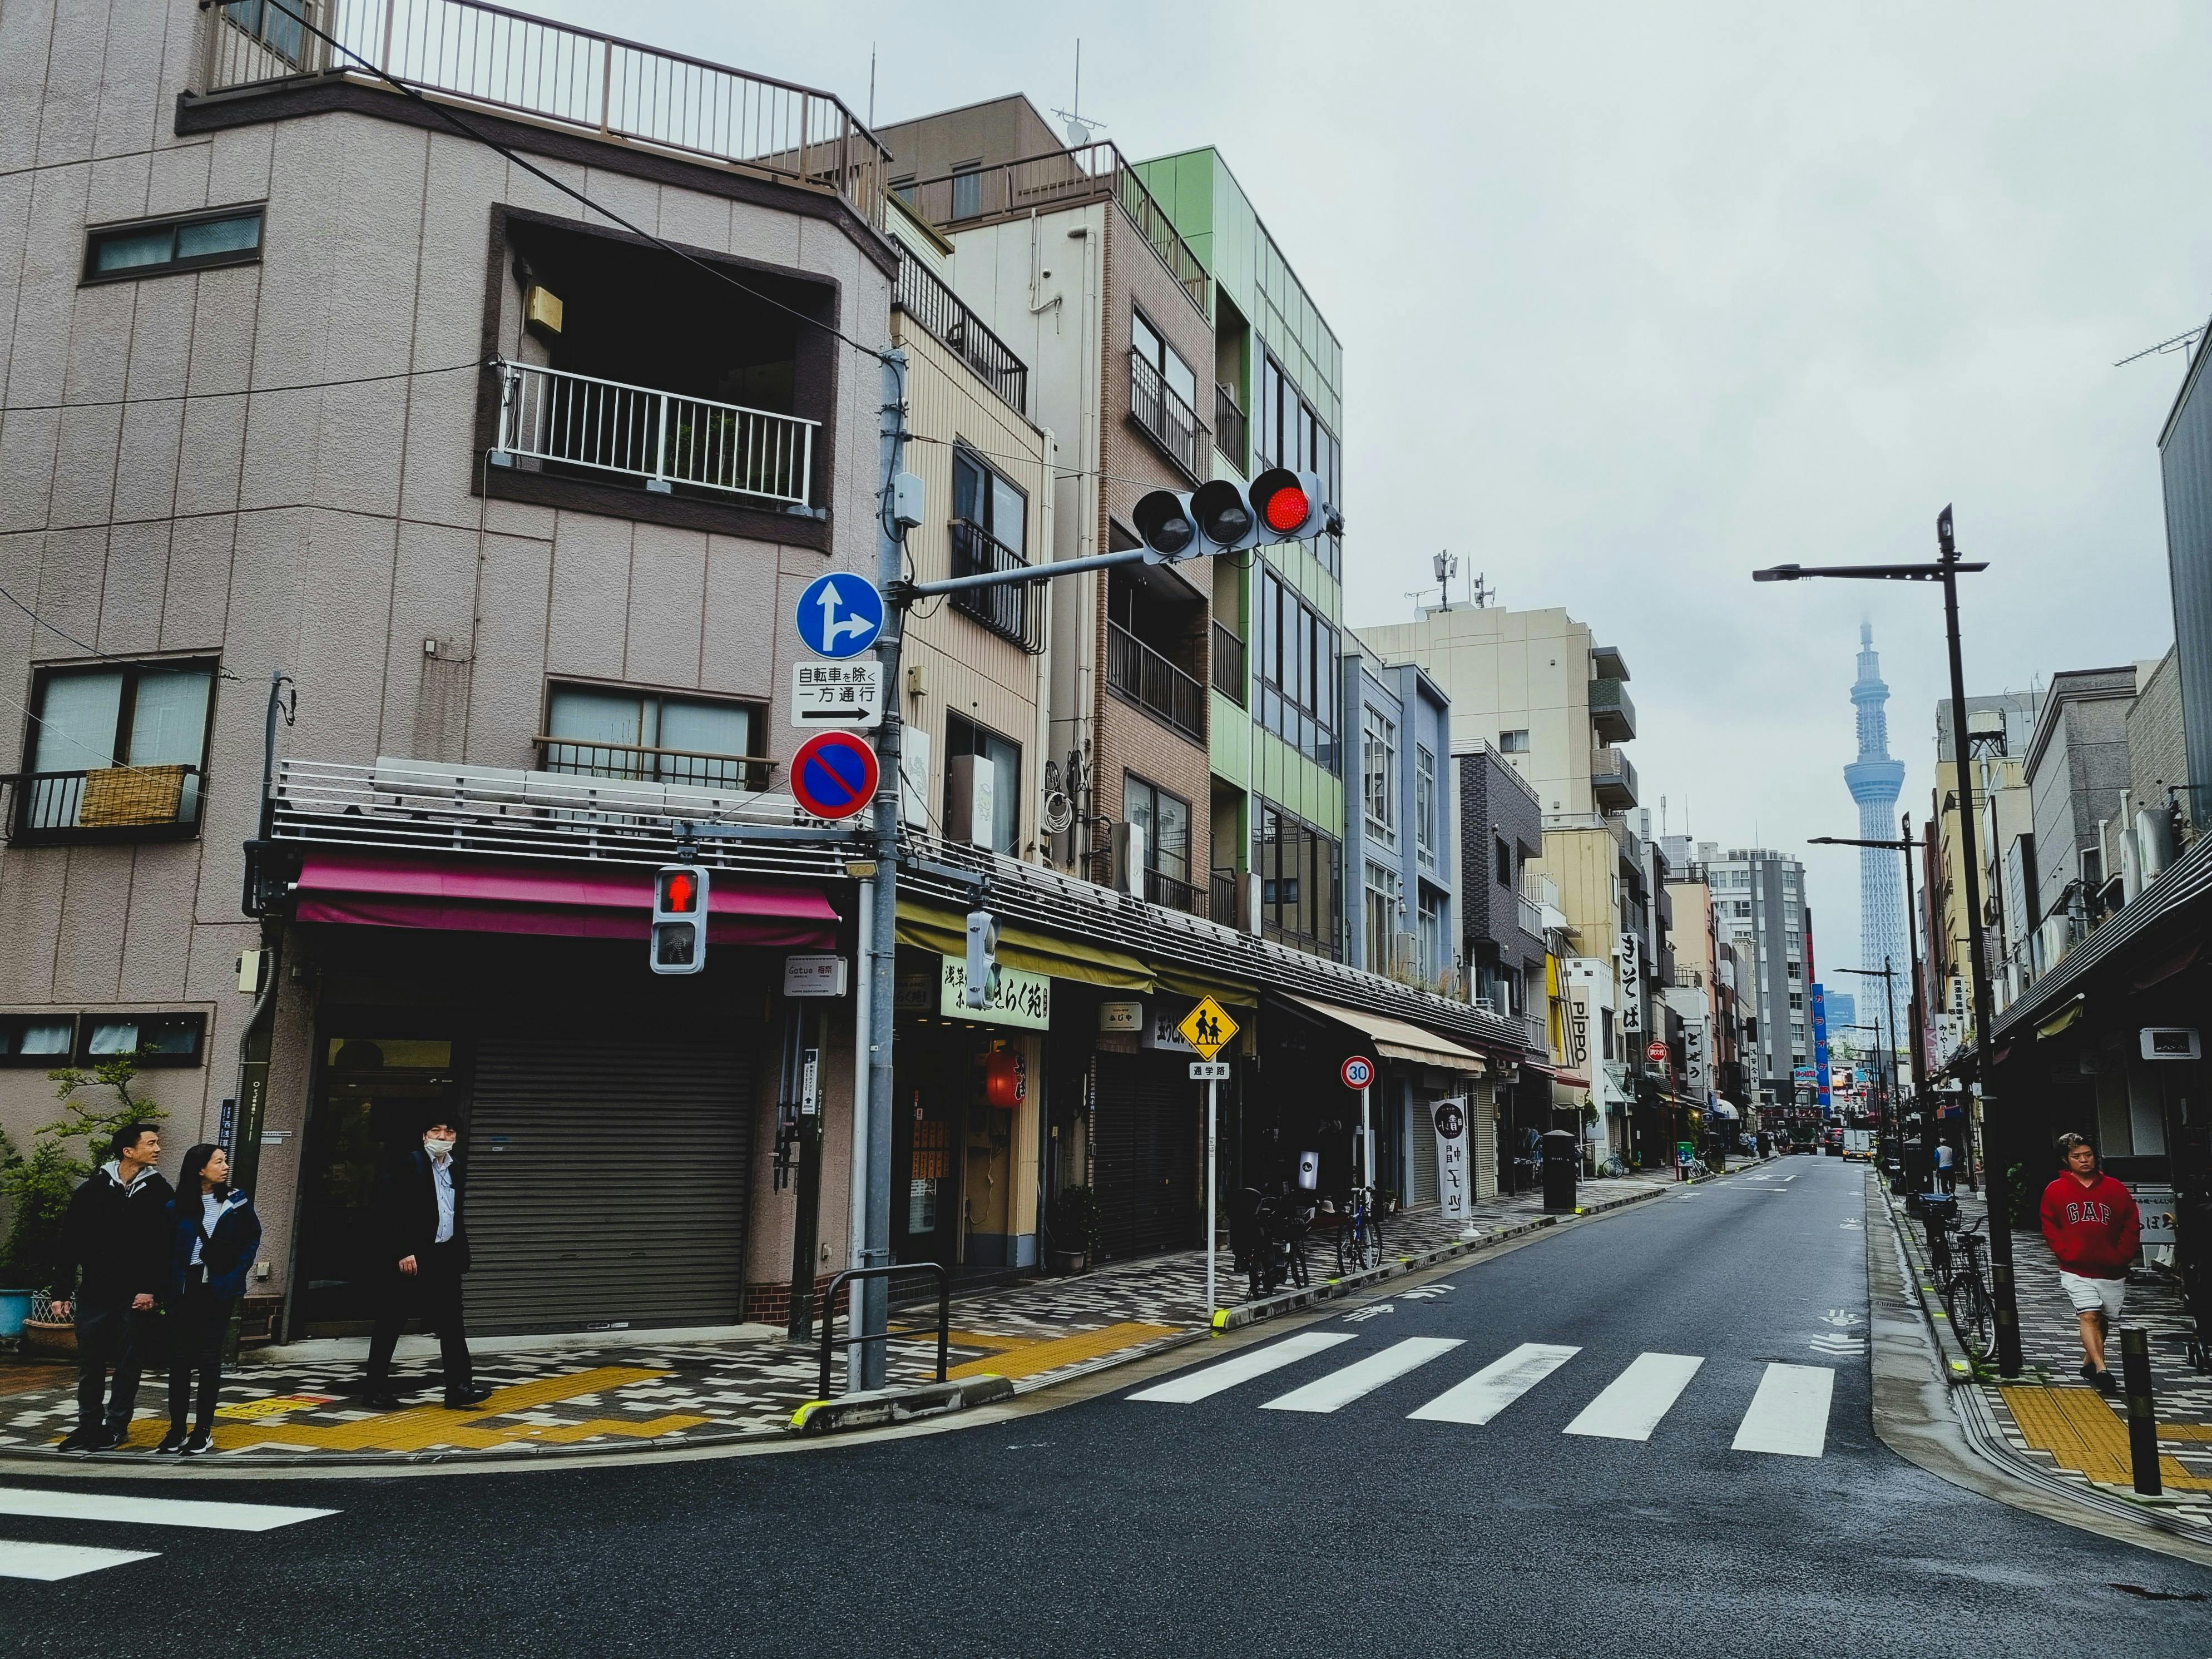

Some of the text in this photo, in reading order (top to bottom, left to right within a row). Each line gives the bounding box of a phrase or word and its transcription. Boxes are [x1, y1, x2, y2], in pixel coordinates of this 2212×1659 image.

[799, 667, 876, 684] 自転車を除く
[799, 687, 876, 702] 一方通行
[1621, 935, 1639, 1028] きそば
[1686, 1032, 1702, 1078] どぜう
[1814, 995, 1829, 1095] カラオケ館
[1194, 1066, 1225, 1076] 通学路
[1349, 1066, 1367, 1081] 30
[2066, 1201, 2111, 1226] GAP
